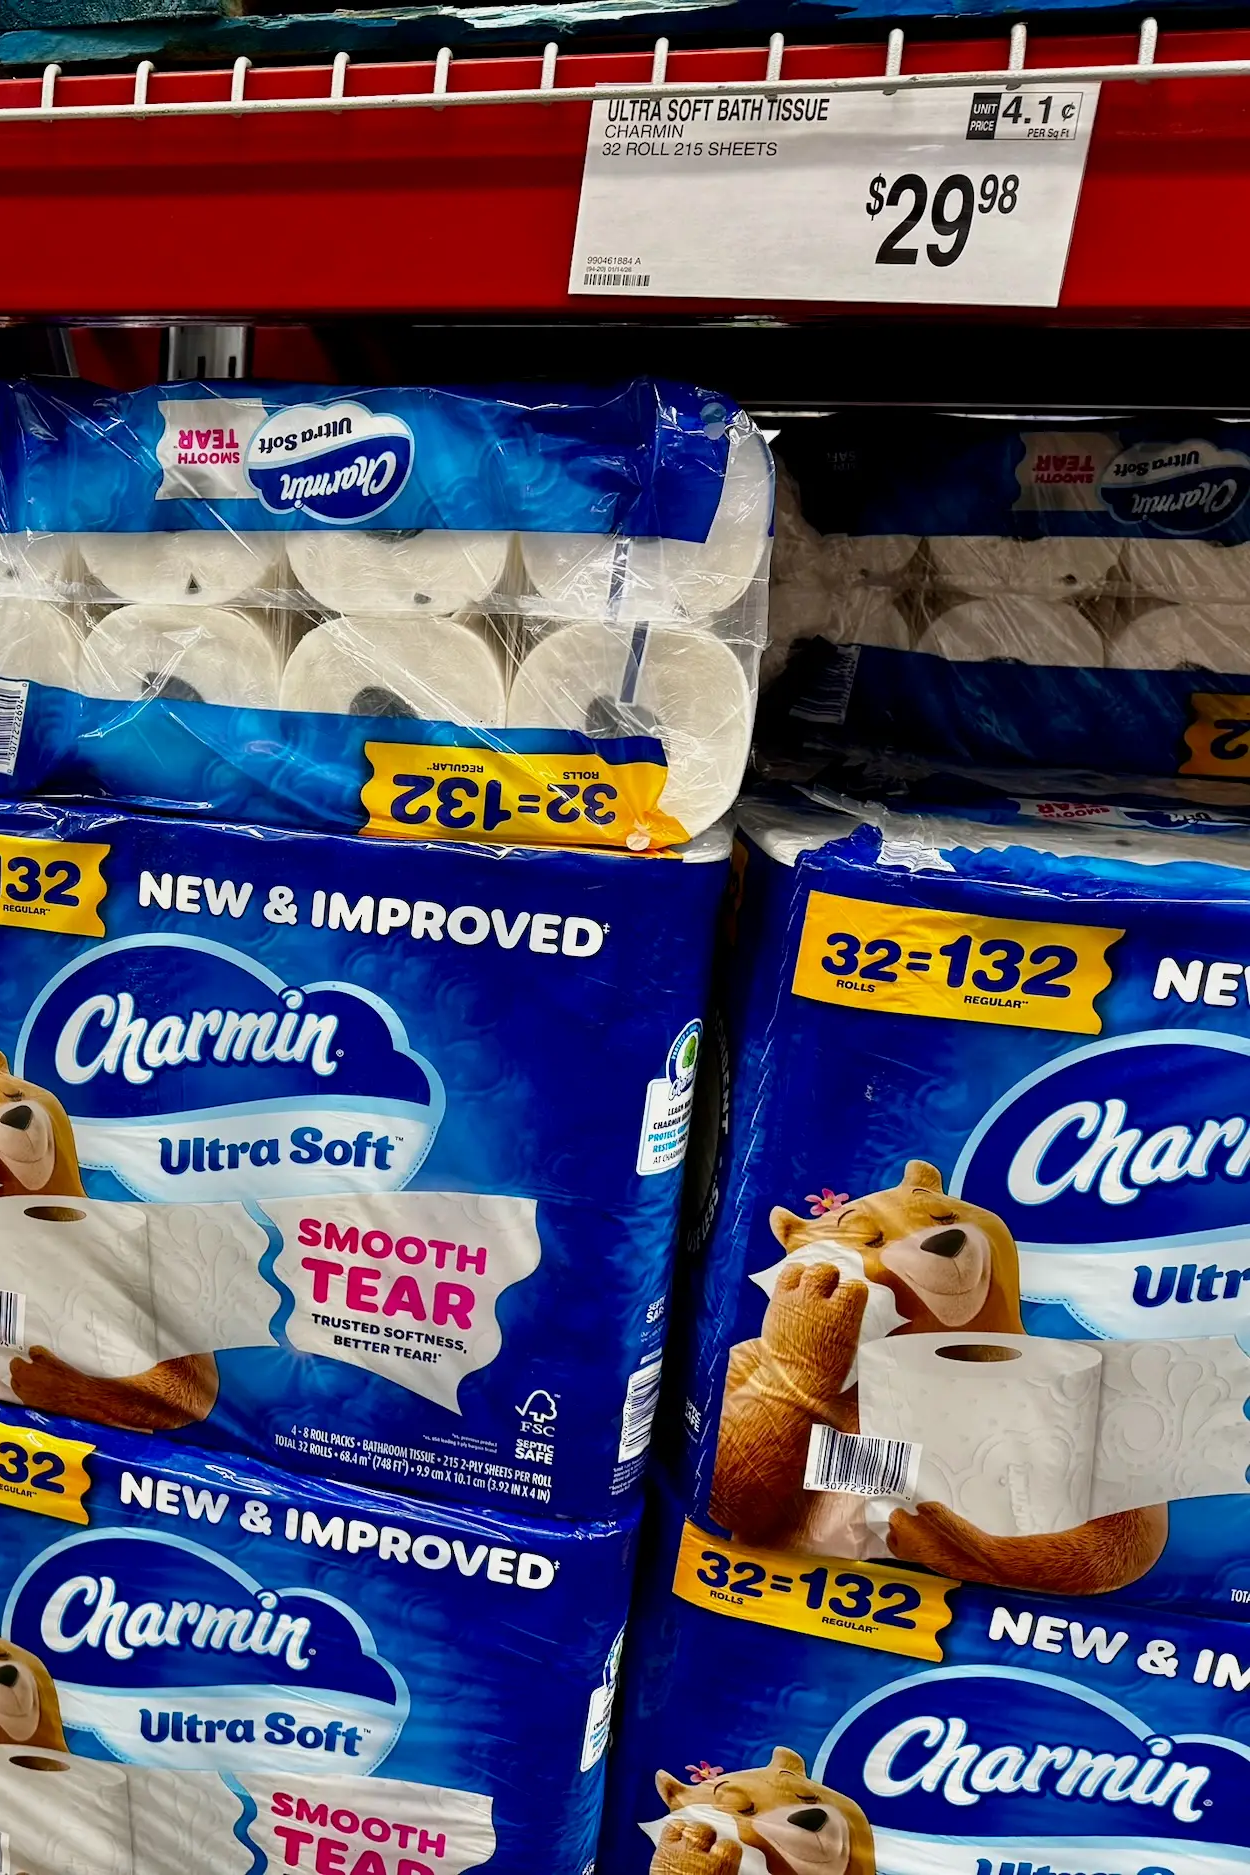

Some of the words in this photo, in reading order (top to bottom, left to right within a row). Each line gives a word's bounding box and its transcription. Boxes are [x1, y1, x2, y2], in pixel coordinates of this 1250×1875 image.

[607, 99, 662, 121] ULTRA
[667, 98, 713, 121] SOFT
[717, 98, 763, 121] BATH
[767, 98, 829, 121] TISSUE
[974, 103, 998, 115] UNIT
[605, 124, 683, 138] CHARMIN
[969, 121, 994, 132] PRICE
[1027, 128, 1045, 138] PER
[1047, 128, 1059, 140] Sq
[1060, 128, 1070, 138] Ft
[602, 142, 621, 156] 32
[626, 142, 669, 156] ROLL
[674, 142, 703, 156] 215
[708, 142, 778, 156] SHEETS
[175, 429, 240, 450] TEAR
[300, 416, 352, 444] Ultra
[259, 433, 295, 455] Soft
[177, 451, 240, 465] SMOOTH
[1036, 455, 1095, 472] TEAR
[1114, 461, 1150, 477] Soft
[1152, 450, 1200, 470] Ultra
[279, 450, 397, 510] Charmin
[1035, 473, 1094, 484] SMOOTH
[1131, 479, 1238, 521] Charmin
[562, 769, 601, 783] ROLLS
[138, 869, 251, 916] NEW
[263, 884, 301, 924] &
[836, 979, 876, 994] ROLLS
[54, 987, 341, 1086] Charmin
[158, 1135, 281, 1177] Ultra
[290, 1126, 395, 1173] Soft
[297, 1217, 488, 1276] SMOOTH
[300, 1257, 475, 1332] TEAR
[311, 1313, 382, 1336] TRUSTED
[384, 1326, 469, 1356] SOFTNESS,
[333, 1335, 392, 1357] BETTER
[519, 1421, 556, 1438] FSC
[514, 1447, 554, 1465] SAFE
[515, 1438, 555, 1453] SEPTIC
[275, 1433, 297, 1450] TOTAL
[297, 1440, 309, 1453] 32
[309, 1442, 333, 1459] ROLLS
[339, 1450, 358, 1464] 68.4
[416, 1464, 430, 1478] 9.9
[431, 1469, 444, 1481] cm
[454, 1472, 471, 1486] 10.1
[472, 1477, 486, 1488] cm
[487, 1477, 509, 1493] (3.92
[510, 1483, 521, 1496] IN
[537, 1489, 551, 1504] IN)
[310, 1428, 329, 1444] ROLL
[330, 1432, 356, 1448] PACKS
[362, 1439, 408, 1459] BATHROOM
[409, 1447, 436, 1464] TISSUE
[443, 1455, 459, 1469] 215
[461, 1458, 483, 1474] 2-PLY
[484, 1463, 513, 1480] SHEETS
[514, 1469, 530, 1483] PER
[531, 1472, 552, 1488] ROLL
[823, 1482, 857, 1492] 30772
[859, 1486, 892, 1496] 22694
[120, 1471, 231, 1526] NEW
[239, 1499, 273, 1536] &
[709, 1588, 744, 1606] ROLLS
[39, 1573, 311, 1672] Charmin
[988, 1606, 1129, 1664] NEW
[1136, 1639, 1179, 1678] &
[138, 1707, 258, 1746] Ultra
[262, 1710, 362, 1757] Soft
[862, 1715, 1212, 1824] Charmin
[270, 1790, 447, 1860] SMOOTH
[273, 1825, 440, 1875] TEAR
